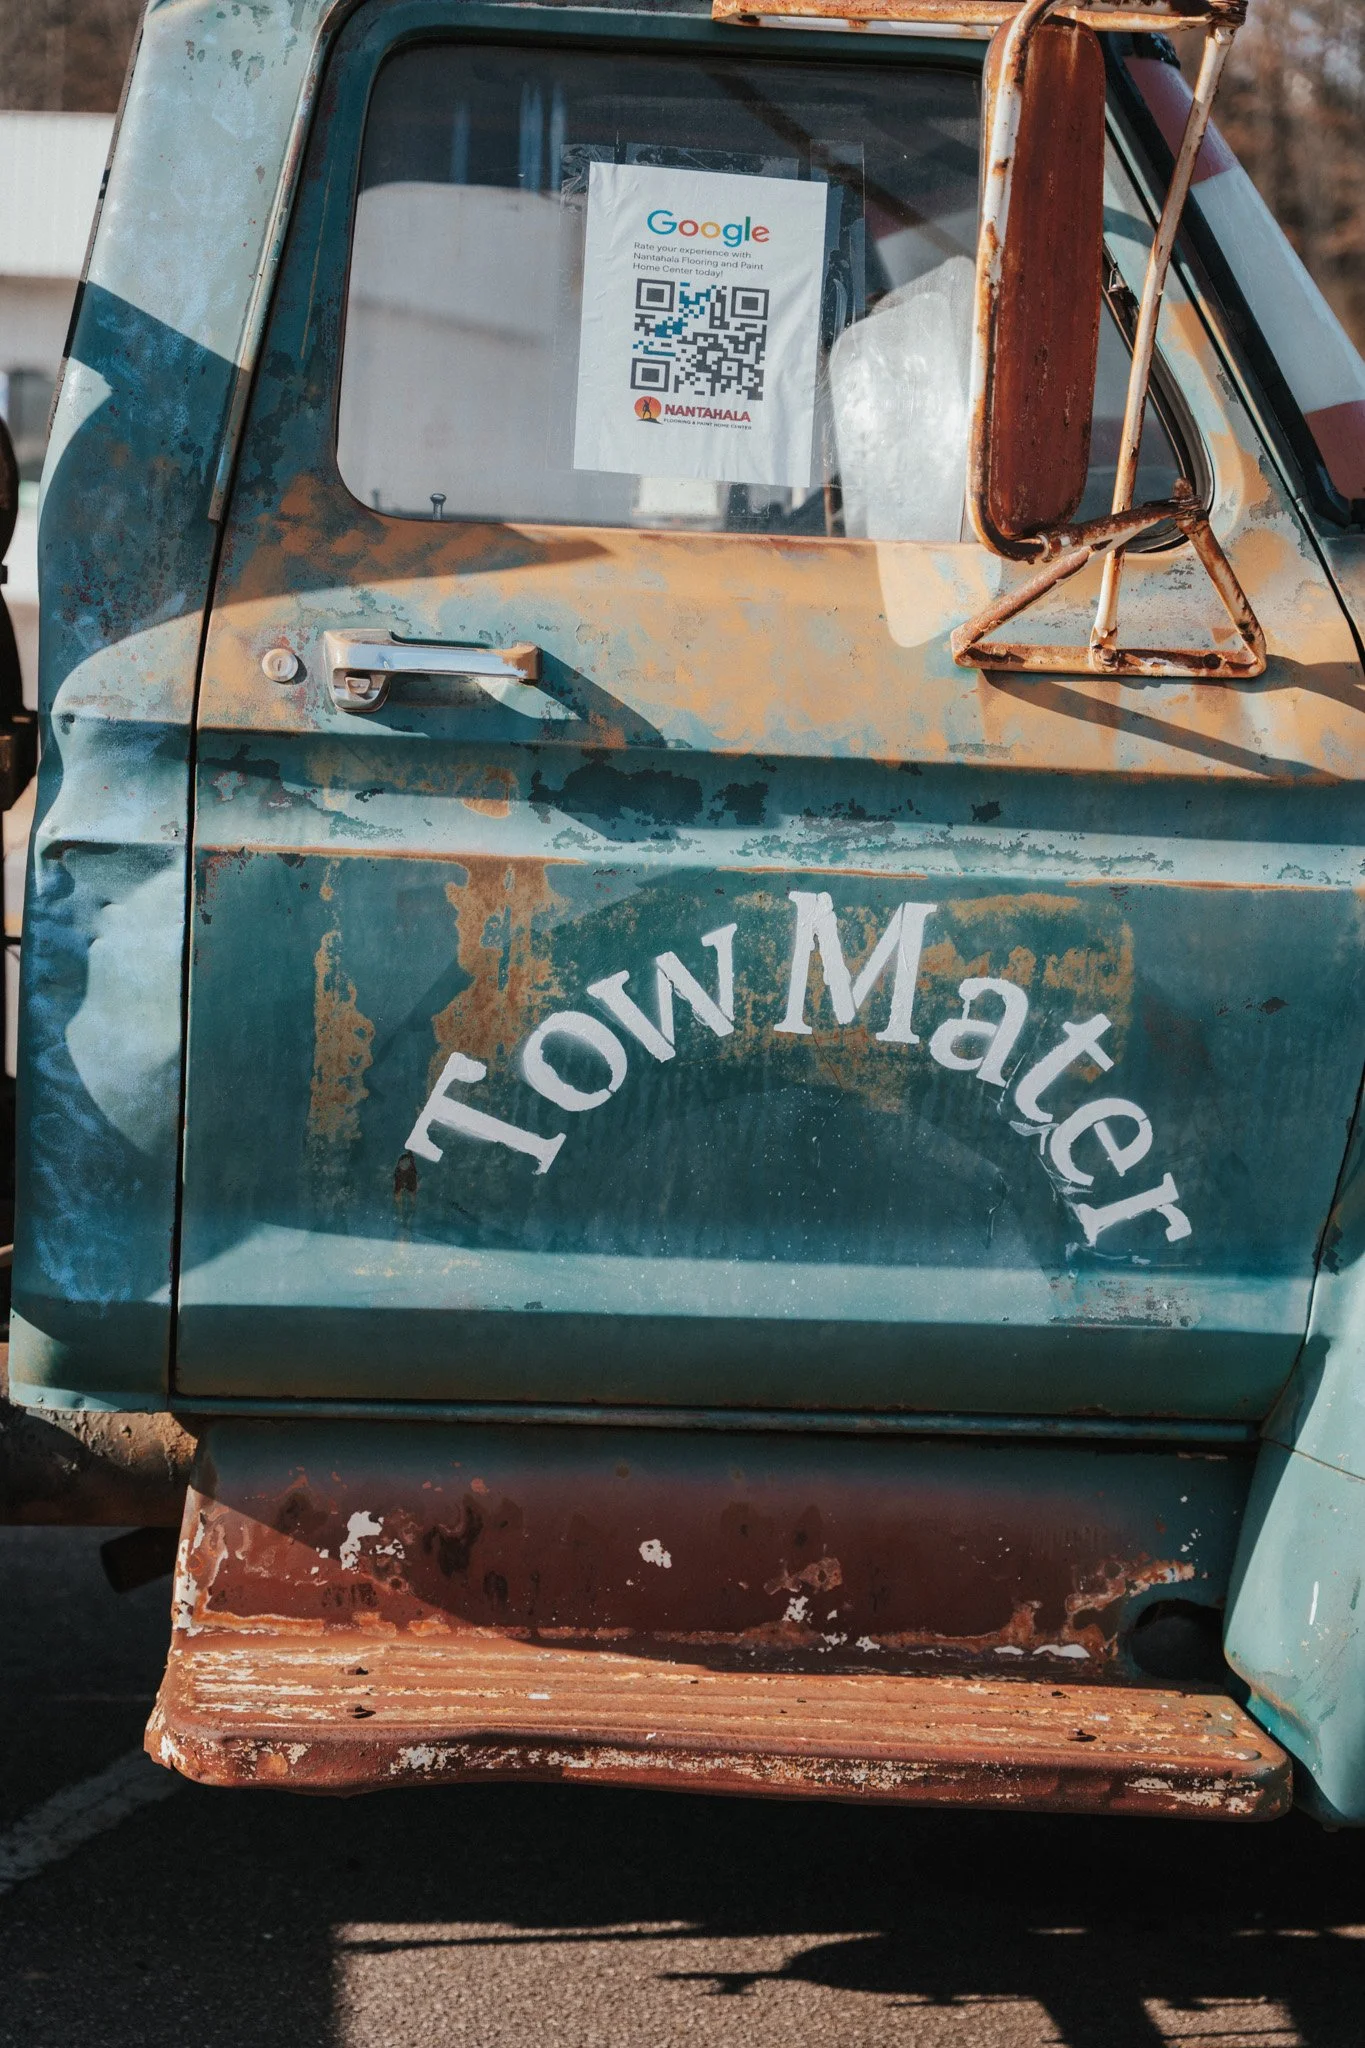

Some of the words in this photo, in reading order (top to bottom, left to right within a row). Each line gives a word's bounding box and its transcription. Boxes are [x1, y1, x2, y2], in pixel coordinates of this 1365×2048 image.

[647, 209, 770, 248] Google
[634, 242, 655, 251] Rate
[656, 245, 677, 253] your
[679, 247, 730, 257] experience
[731, 250, 752, 259] with
[633, 252, 680, 263] Nantahala
[682, 257, 719, 269] Flooring
[721, 260, 739, 269] and
[740, 261, 764, 270] Paint
[633, 262, 661, 272] Home
[662, 265, 693, 275] Center
[695, 268, 724, 278] today!
[664, 403, 751, 422] NANTAHALA
[405, 924, 738, 1176] Tow
[774, 891, 1193, 1247] Mater
